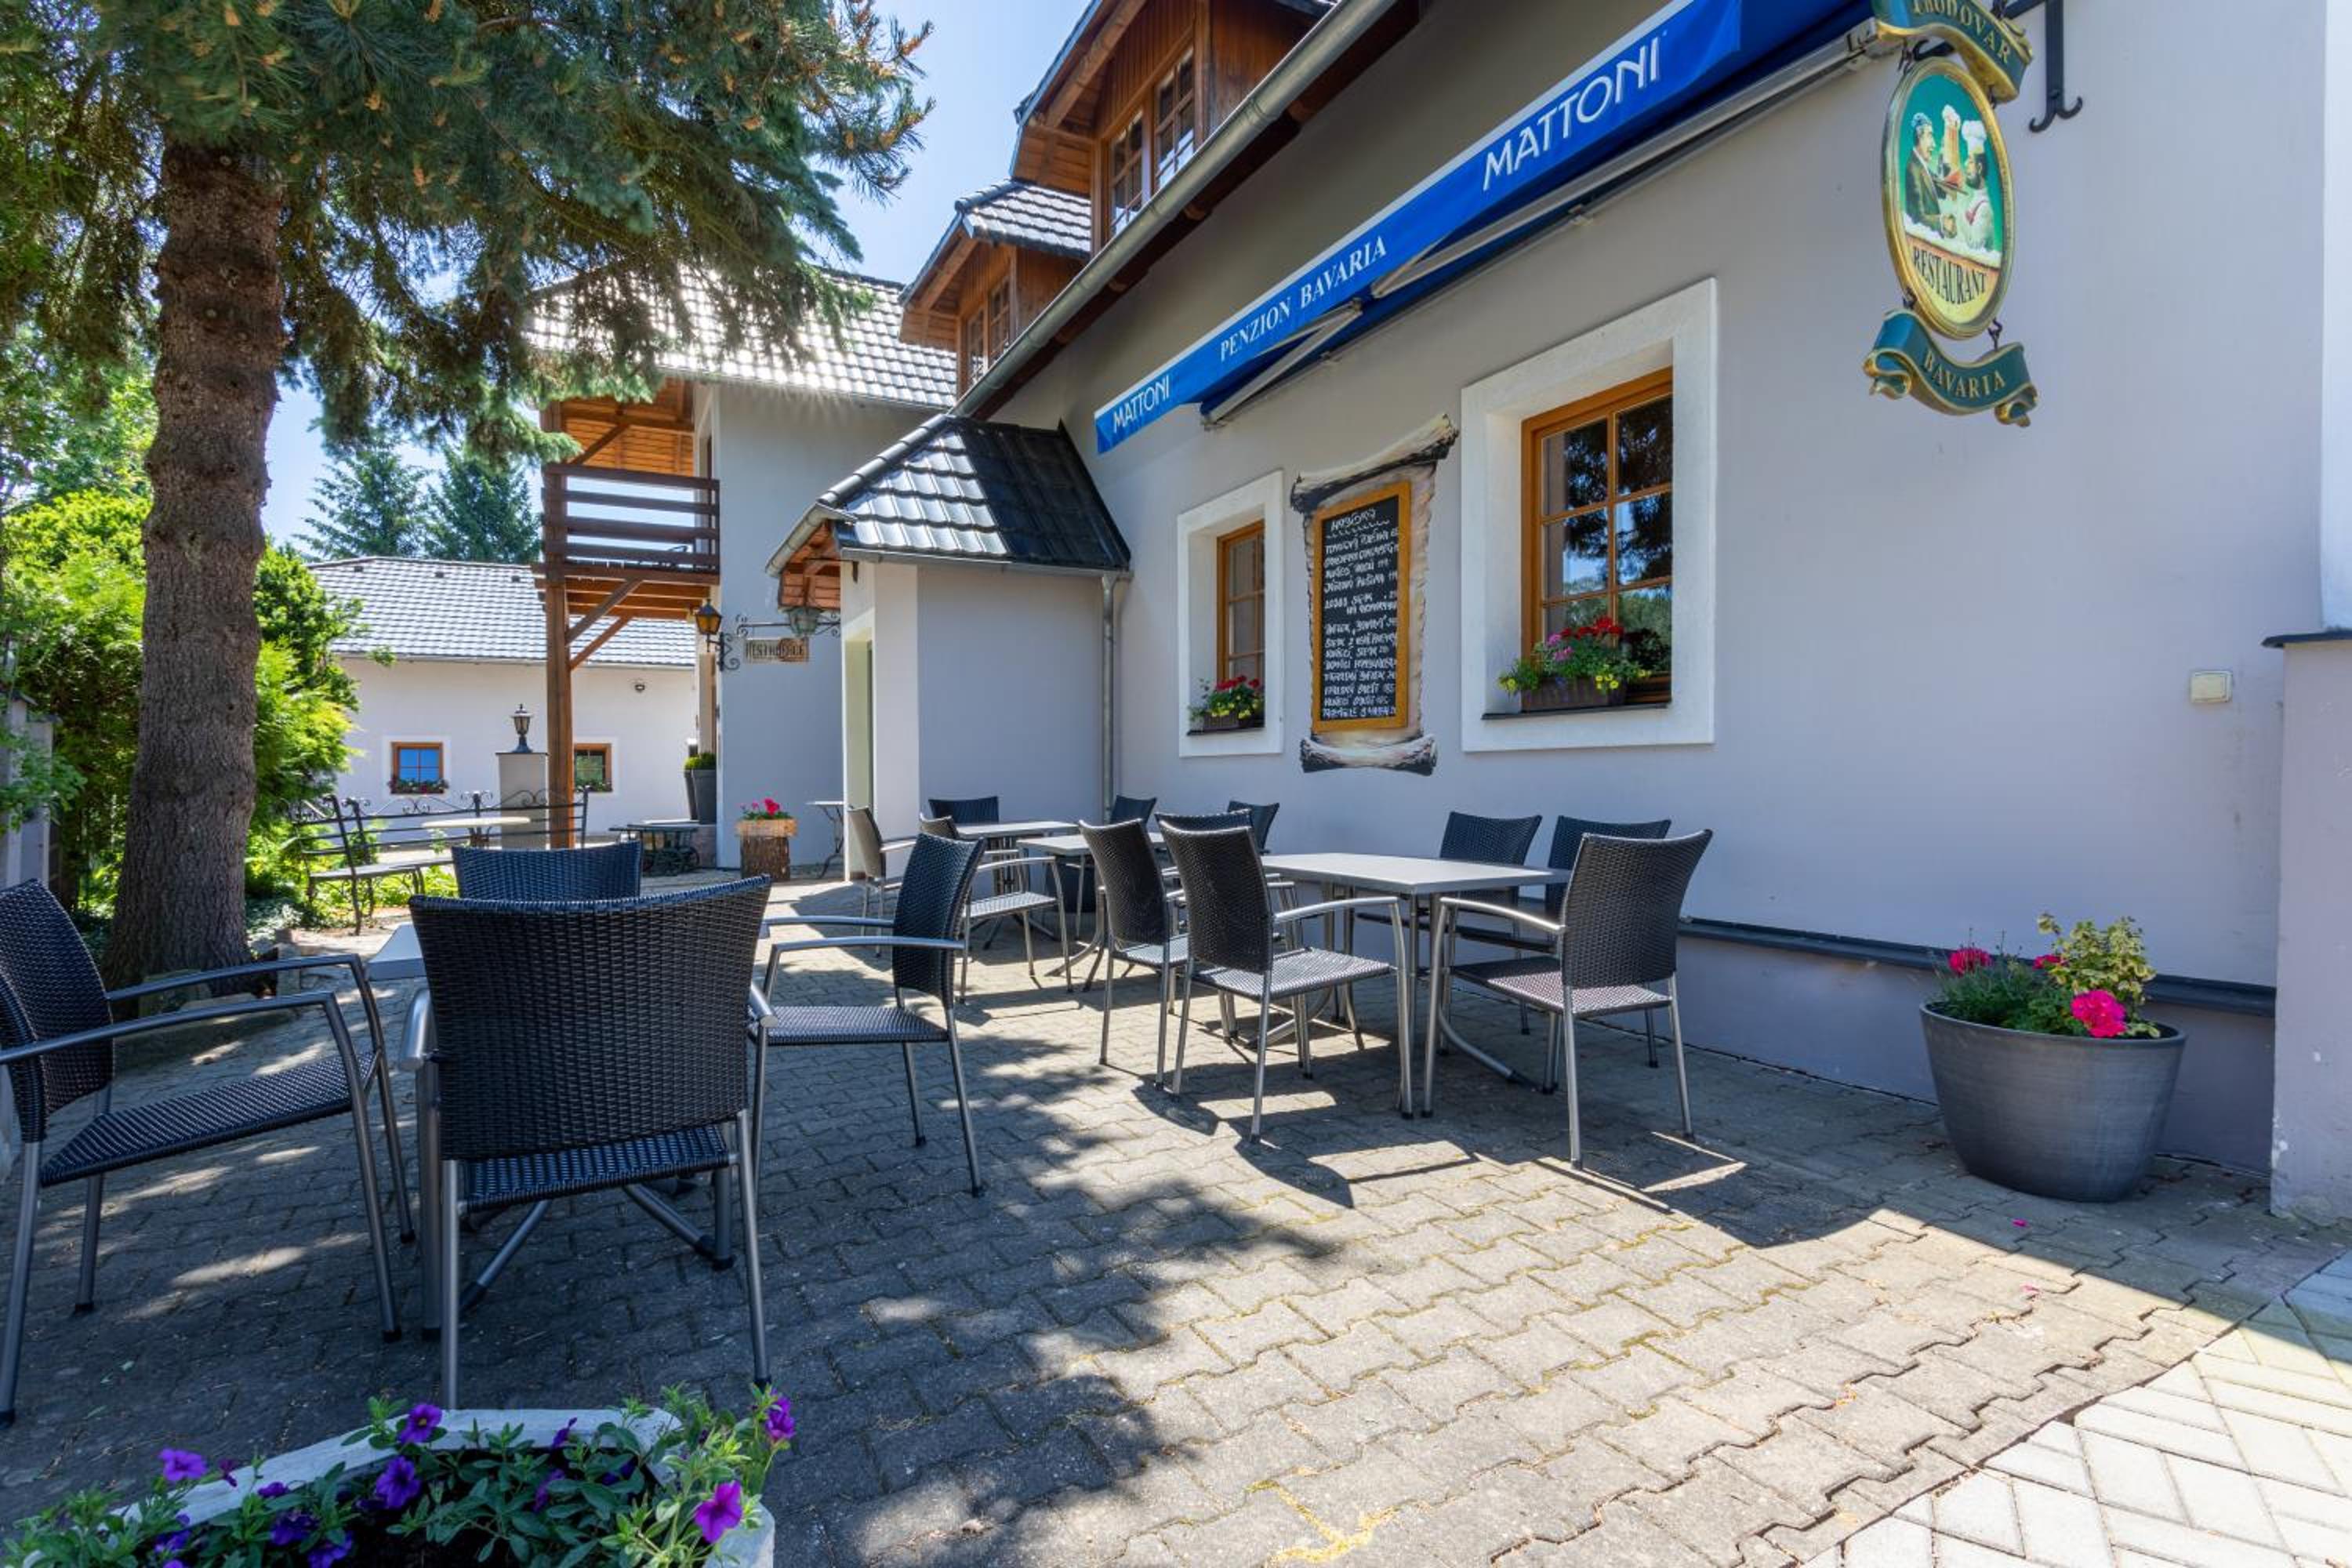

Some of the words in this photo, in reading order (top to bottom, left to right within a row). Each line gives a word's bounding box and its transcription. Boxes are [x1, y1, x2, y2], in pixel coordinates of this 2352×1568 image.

[1483, 36, 1660, 192] MATTONI
[1220, 296, 1292, 362] PENZION
[1301, 235, 1387, 309] BAVARIA
[1913, 246, 1987, 304] RESTAURANT
[1112, 374, 1170, 434] MATTONI
[1924, 350, 2005, 398] BAVARIA
